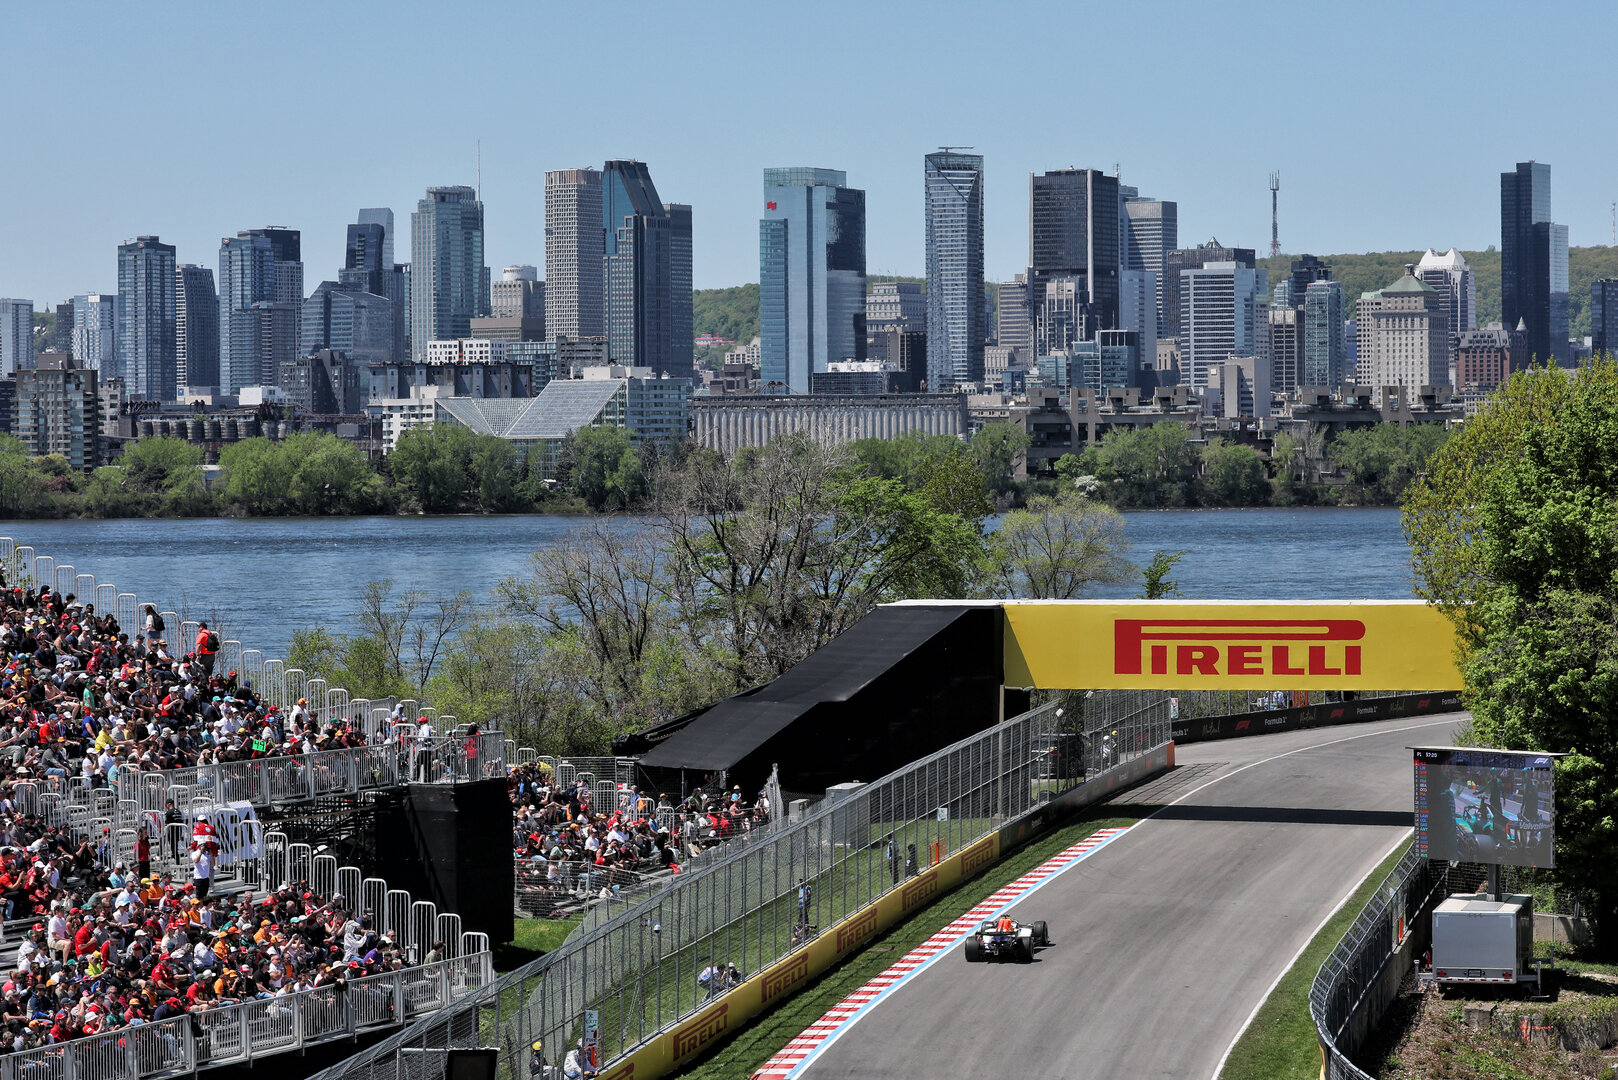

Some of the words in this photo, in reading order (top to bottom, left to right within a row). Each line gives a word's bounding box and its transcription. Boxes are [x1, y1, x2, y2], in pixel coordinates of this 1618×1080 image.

[1114, 619, 1366, 675] PIRELLI
[1264, 717, 1283, 726] Formula
[961, 838, 994, 875] PIRELLI
[902, 871, 938, 912] PIRELLI
[836, 908, 877, 954] PIRELLI
[761, 952, 809, 1004] PIRELLI
[673, 1002, 729, 1062] PIRELLI
